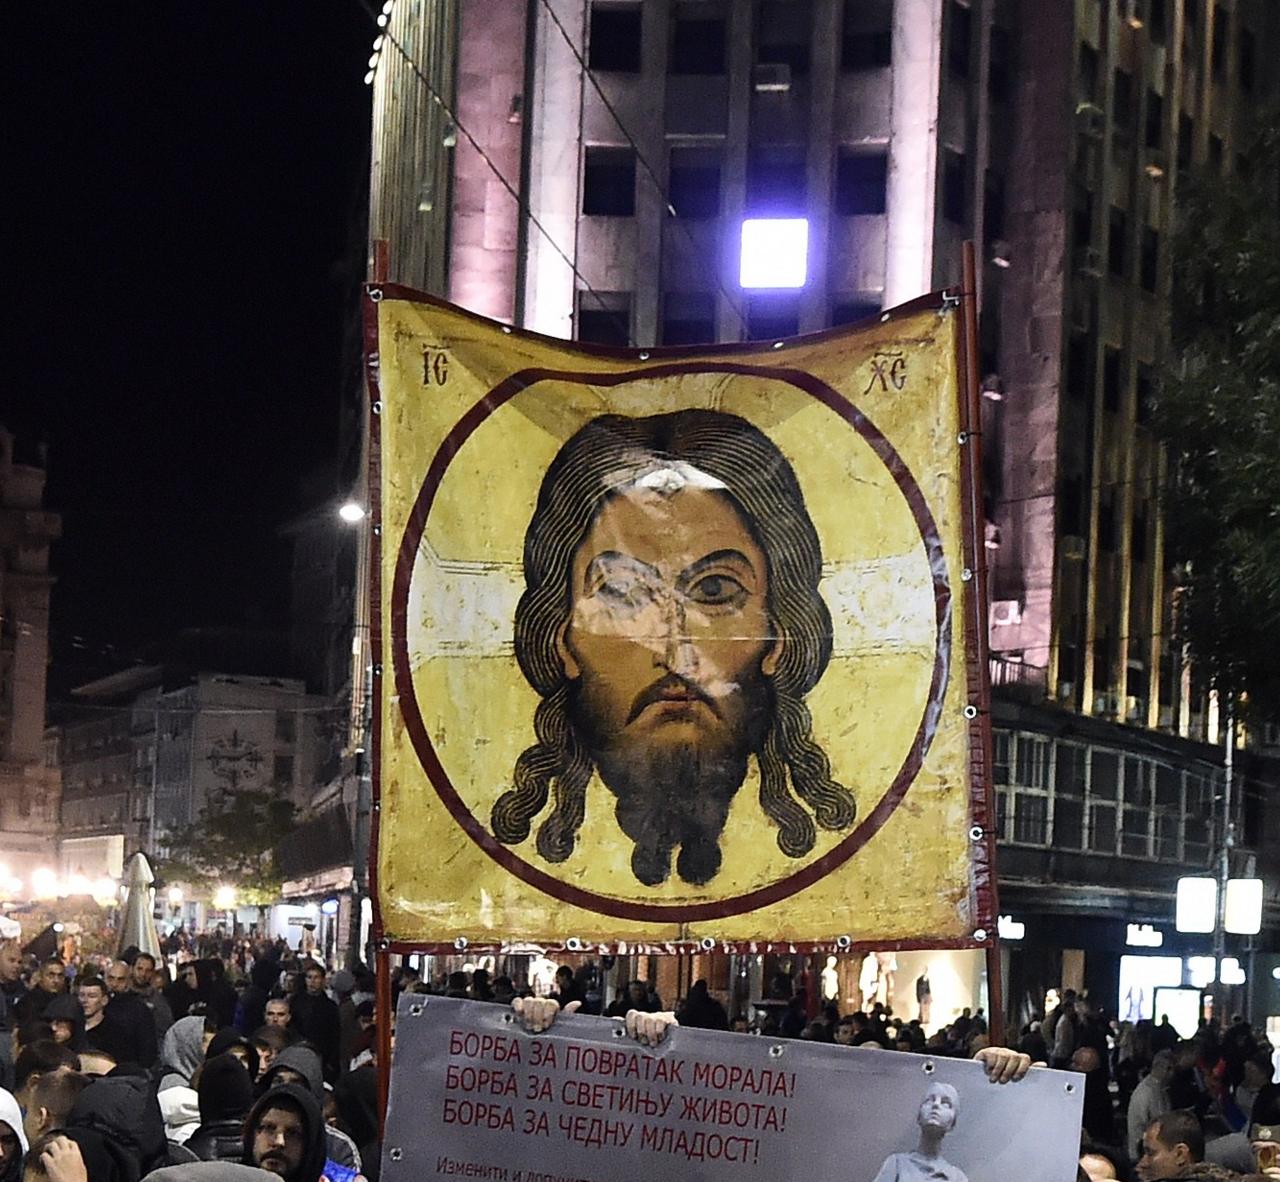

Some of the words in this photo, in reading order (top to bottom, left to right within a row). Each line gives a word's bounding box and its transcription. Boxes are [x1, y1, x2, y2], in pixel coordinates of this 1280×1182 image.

[449, 1030, 522, 1064] БОРБА
[528, 1041, 558, 1070] ЗА
[565, 1046, 684, 1085] ПОВРАТАК
[693, 1062, 798, 1099] МОРАЛА!
[442, 1098, 516, 1133] БОРБА
[523, 1110, 551, 1138] ЗА
[558, 1115, 635, 1151] ЧЕДНУ
[641, 1128, 761, 1165] МЛАДОСТ!
[445, 1065, 519, 1097] БОРБА
[526, 1074, 554, 1103] ЗА
[561, 1081, 674, 1119] СВЕТИЊУ
[679, 1095, 788, 1133] ЖИВОТА!
[435, 1156, 509, 1182] Изменити
